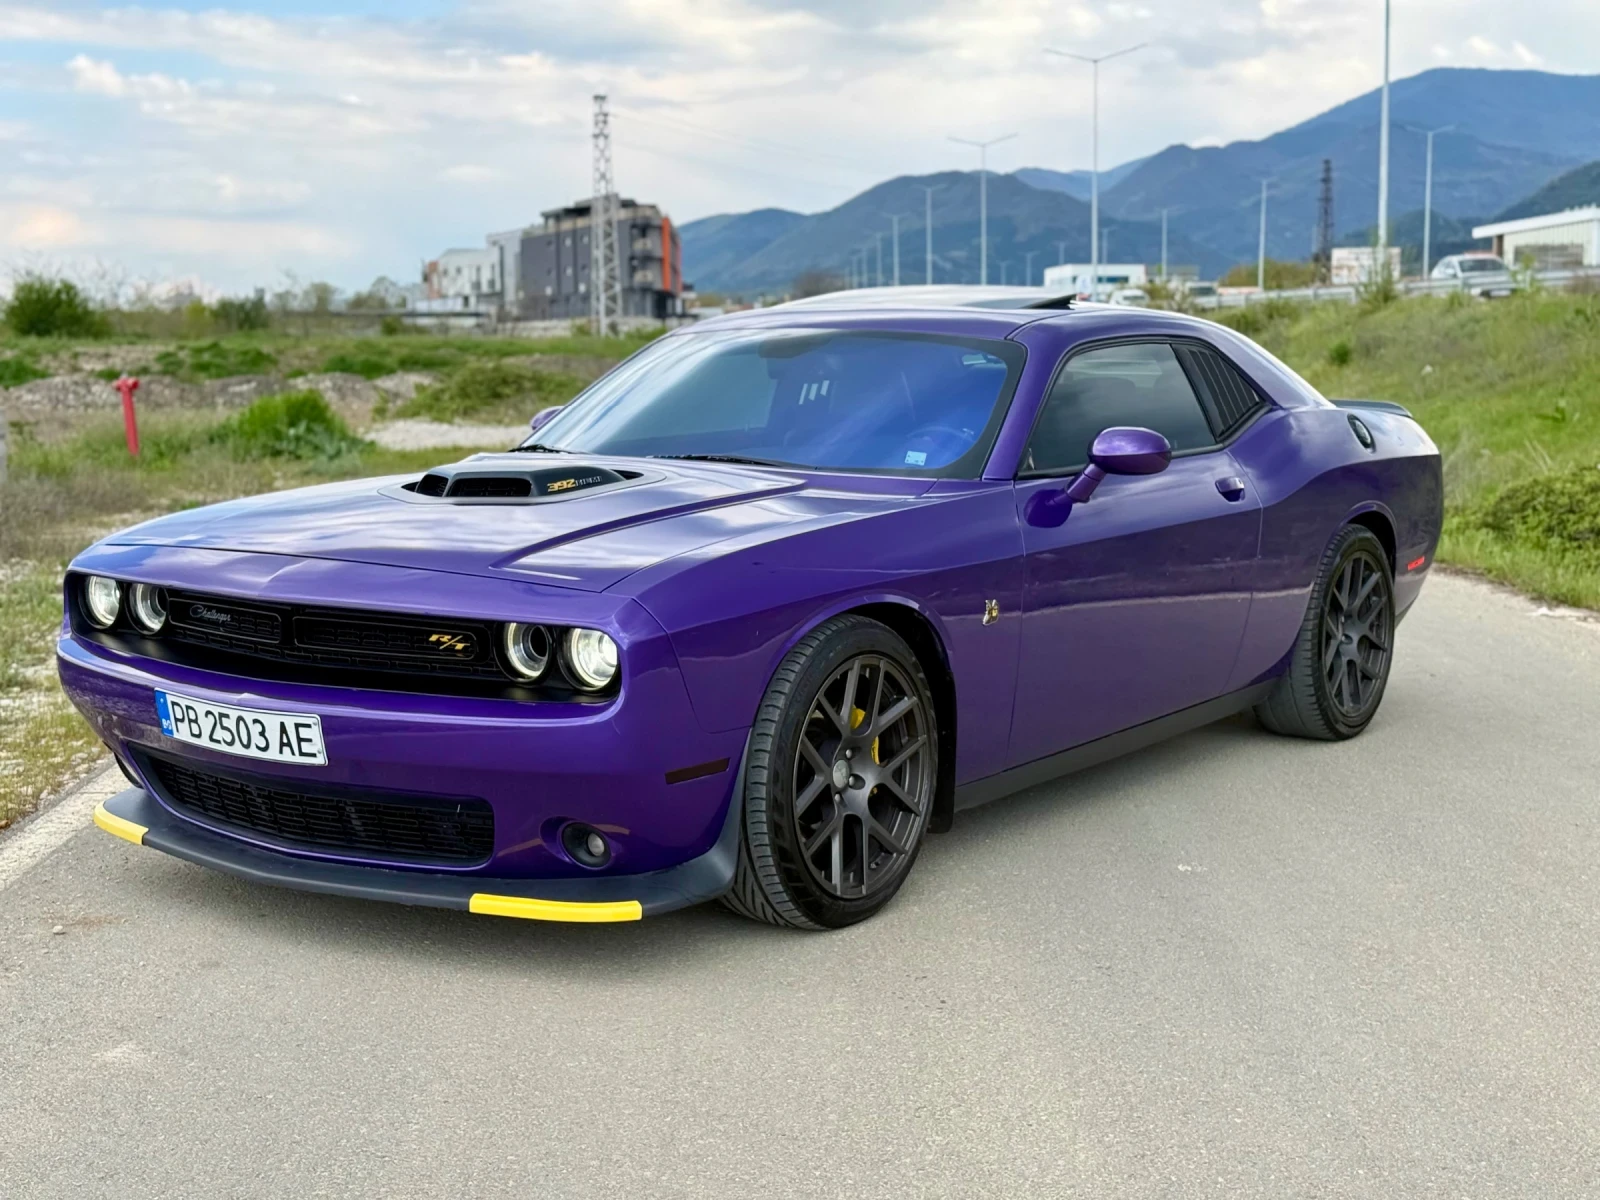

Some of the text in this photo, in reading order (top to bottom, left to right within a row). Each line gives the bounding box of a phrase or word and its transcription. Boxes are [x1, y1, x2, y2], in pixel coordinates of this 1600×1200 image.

[547, 478, 575, 492] 392
[429, 634, 470, 650] R/T
[170, 700, 317, 758] PB 2503 AE
